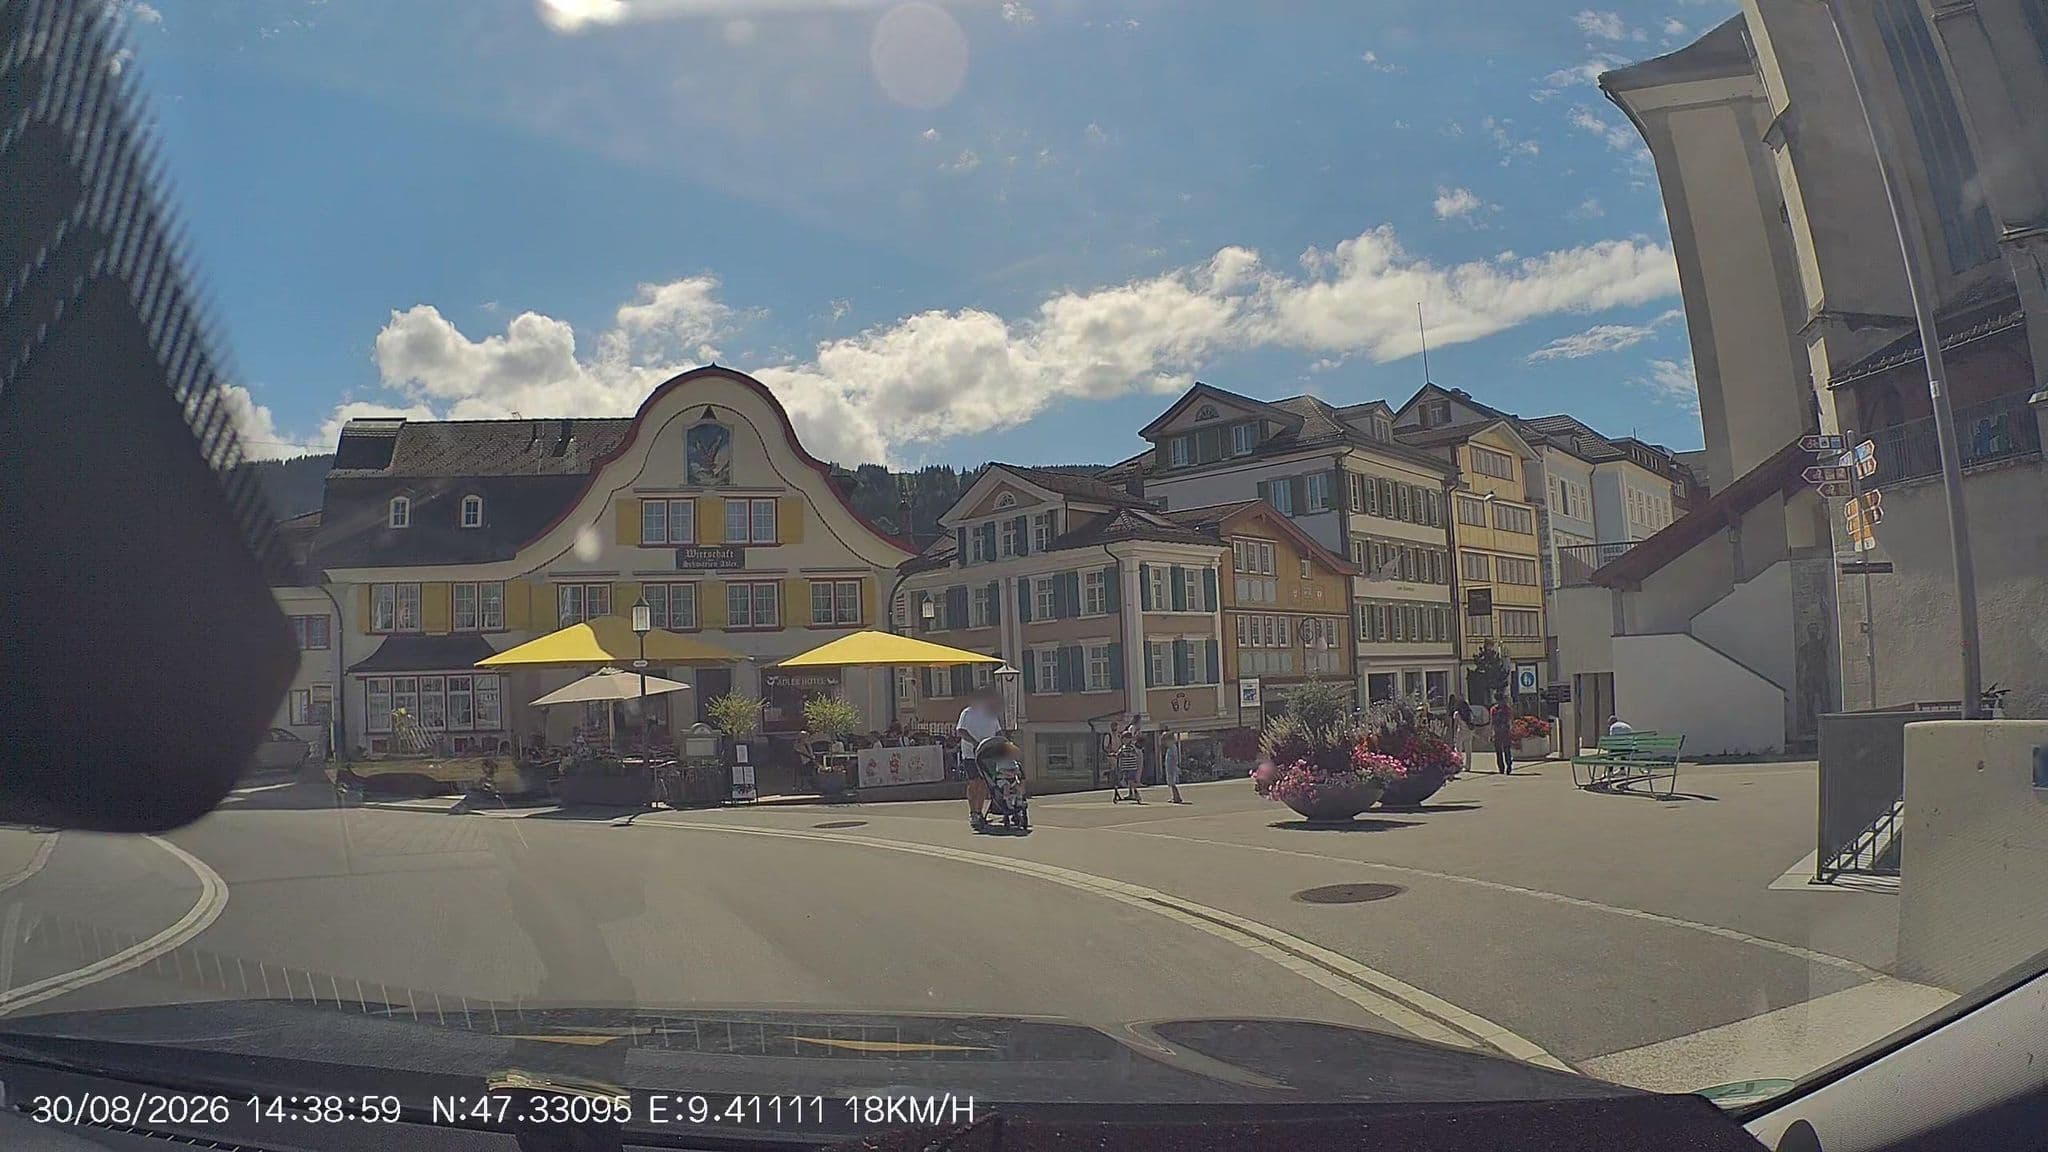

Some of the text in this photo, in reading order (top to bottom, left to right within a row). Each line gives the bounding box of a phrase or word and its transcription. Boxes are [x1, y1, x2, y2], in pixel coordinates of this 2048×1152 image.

[686, 549, 734, 559] Wirtschaft
[776, 677, 825, 686] ADLER HOTEL
